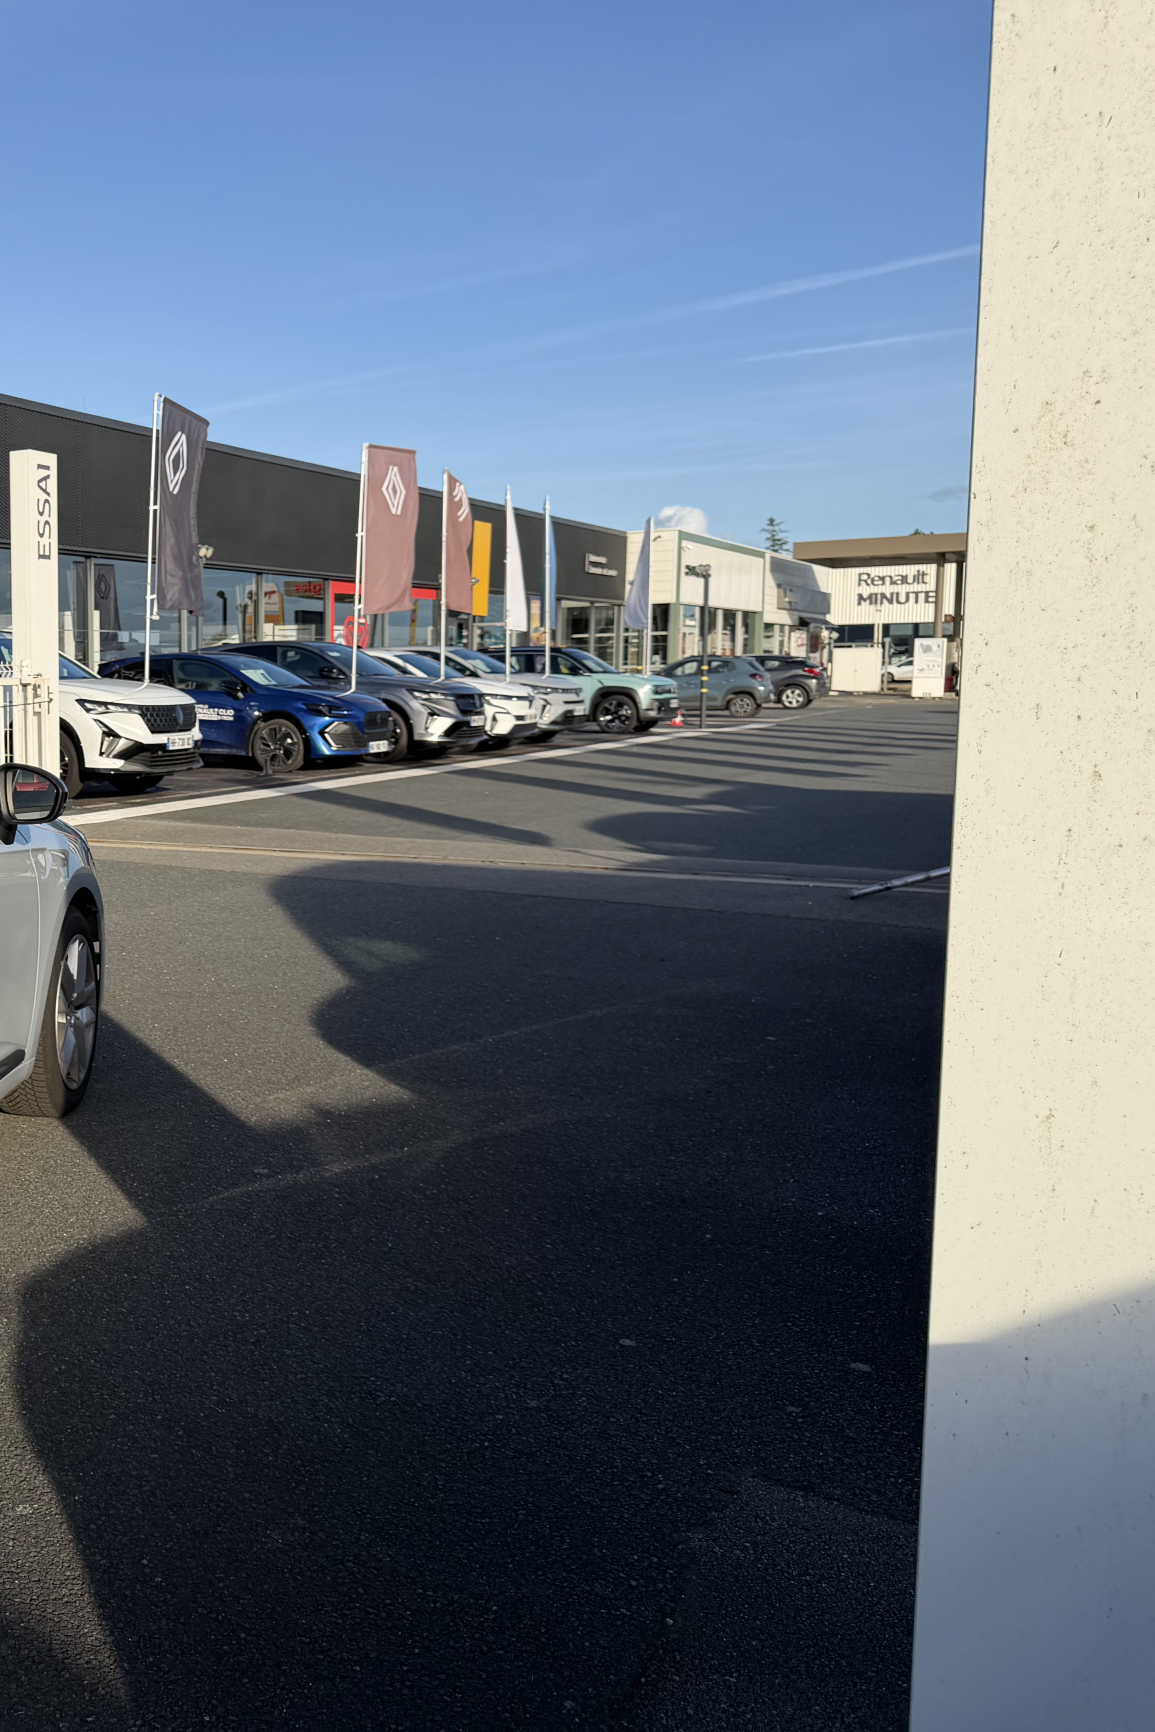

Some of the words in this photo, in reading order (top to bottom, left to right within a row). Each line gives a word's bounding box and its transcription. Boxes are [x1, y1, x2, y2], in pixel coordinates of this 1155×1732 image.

[37, 462, 52, 561] ESSAI
[857, 569, 929, 587] Renault
[857, 590, 936, 606] MINUTE
